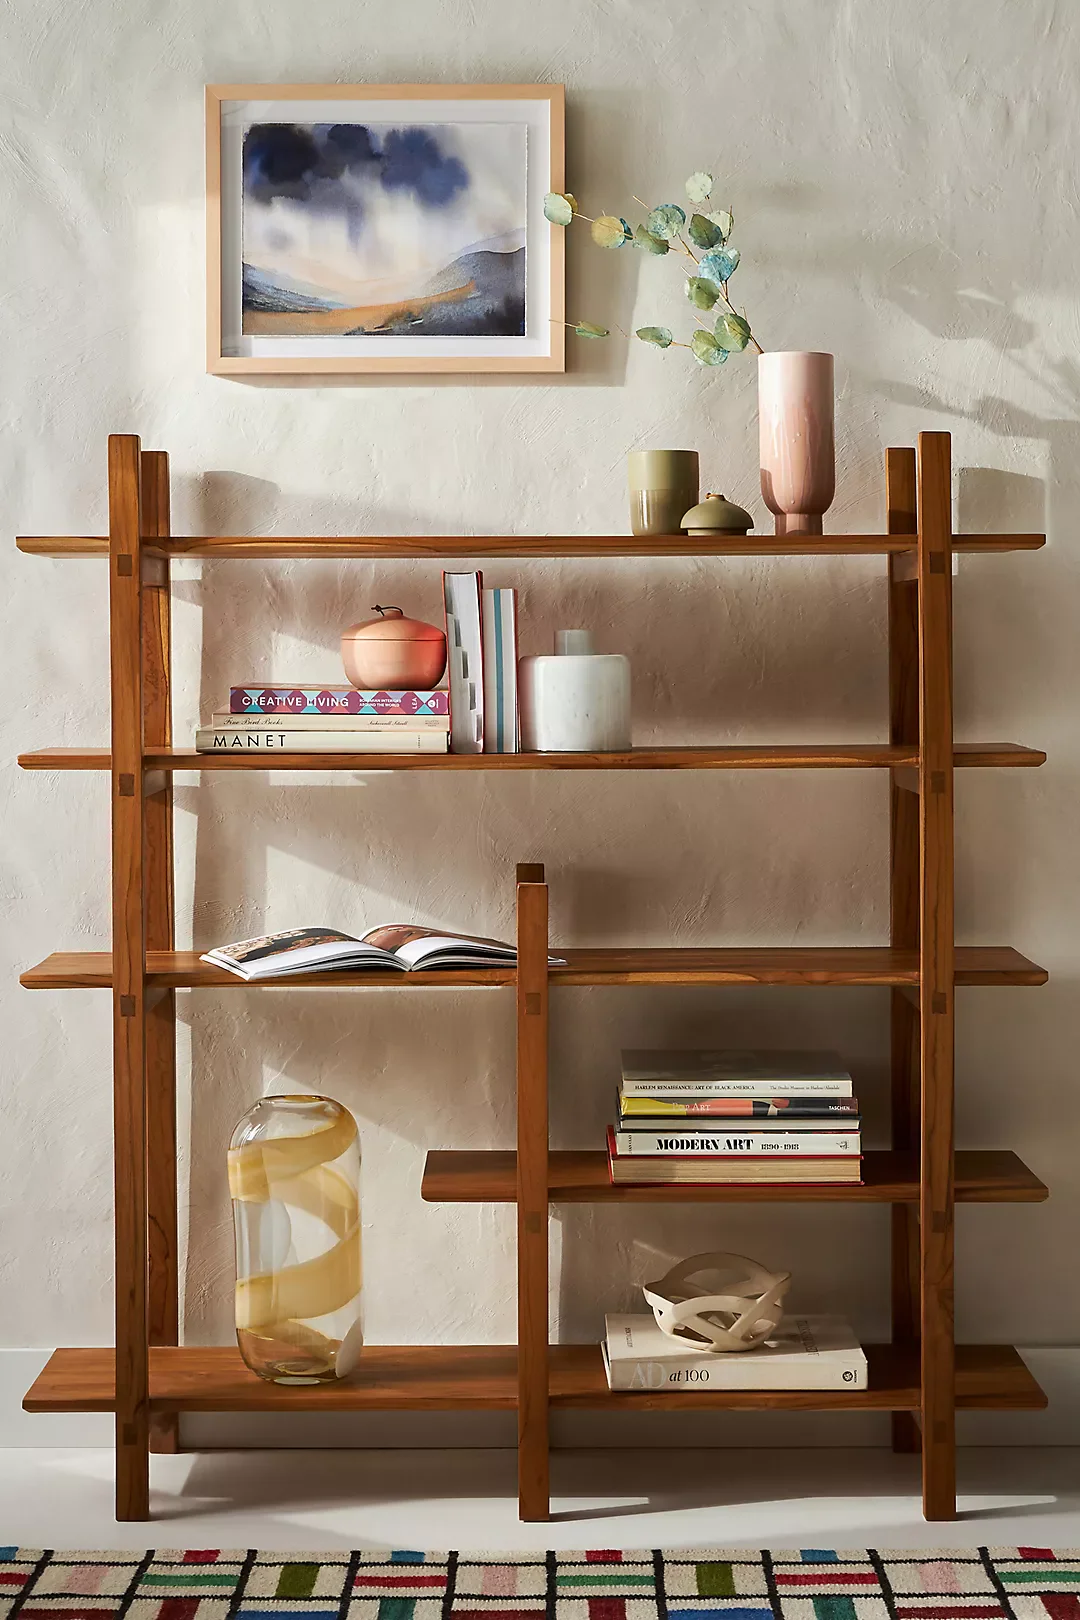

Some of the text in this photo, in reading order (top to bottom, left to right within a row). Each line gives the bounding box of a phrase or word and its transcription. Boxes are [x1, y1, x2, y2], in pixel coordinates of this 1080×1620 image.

[241, 696, 349, 707] CREATIVE LIVING
[223, 716, 239, 725] Fine
[241, 717, 261, 725] Bird
[213, 734, 286, 747] MANET
[656, 1138, 720, 1150] MODERN
[722, 1138, 754, 1150] ART
[628, 1361, 710, 1389] AD at 100
